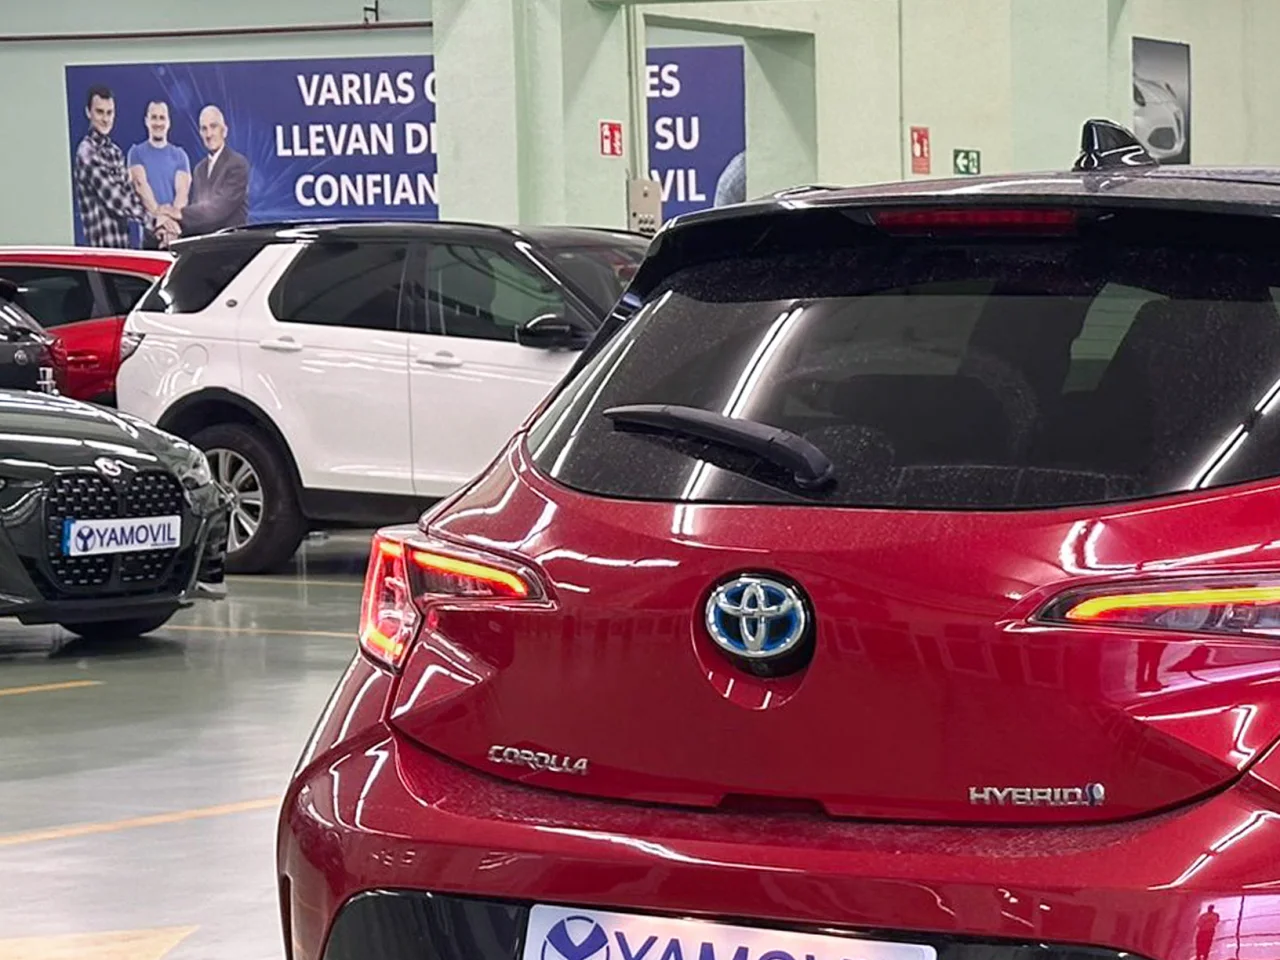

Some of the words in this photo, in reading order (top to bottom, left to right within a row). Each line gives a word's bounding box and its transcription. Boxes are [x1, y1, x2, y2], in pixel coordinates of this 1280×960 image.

[297, 71, 415, 106] VARIAS
[275, 123, 394, 156] LLEVAN
[655, 116, 699, 150] SU
[95, 523, 177, 548] YAMOVIL
[488, 744, 589, 776] COROLLA
[968, 786, 1083, 806] HYBRID
